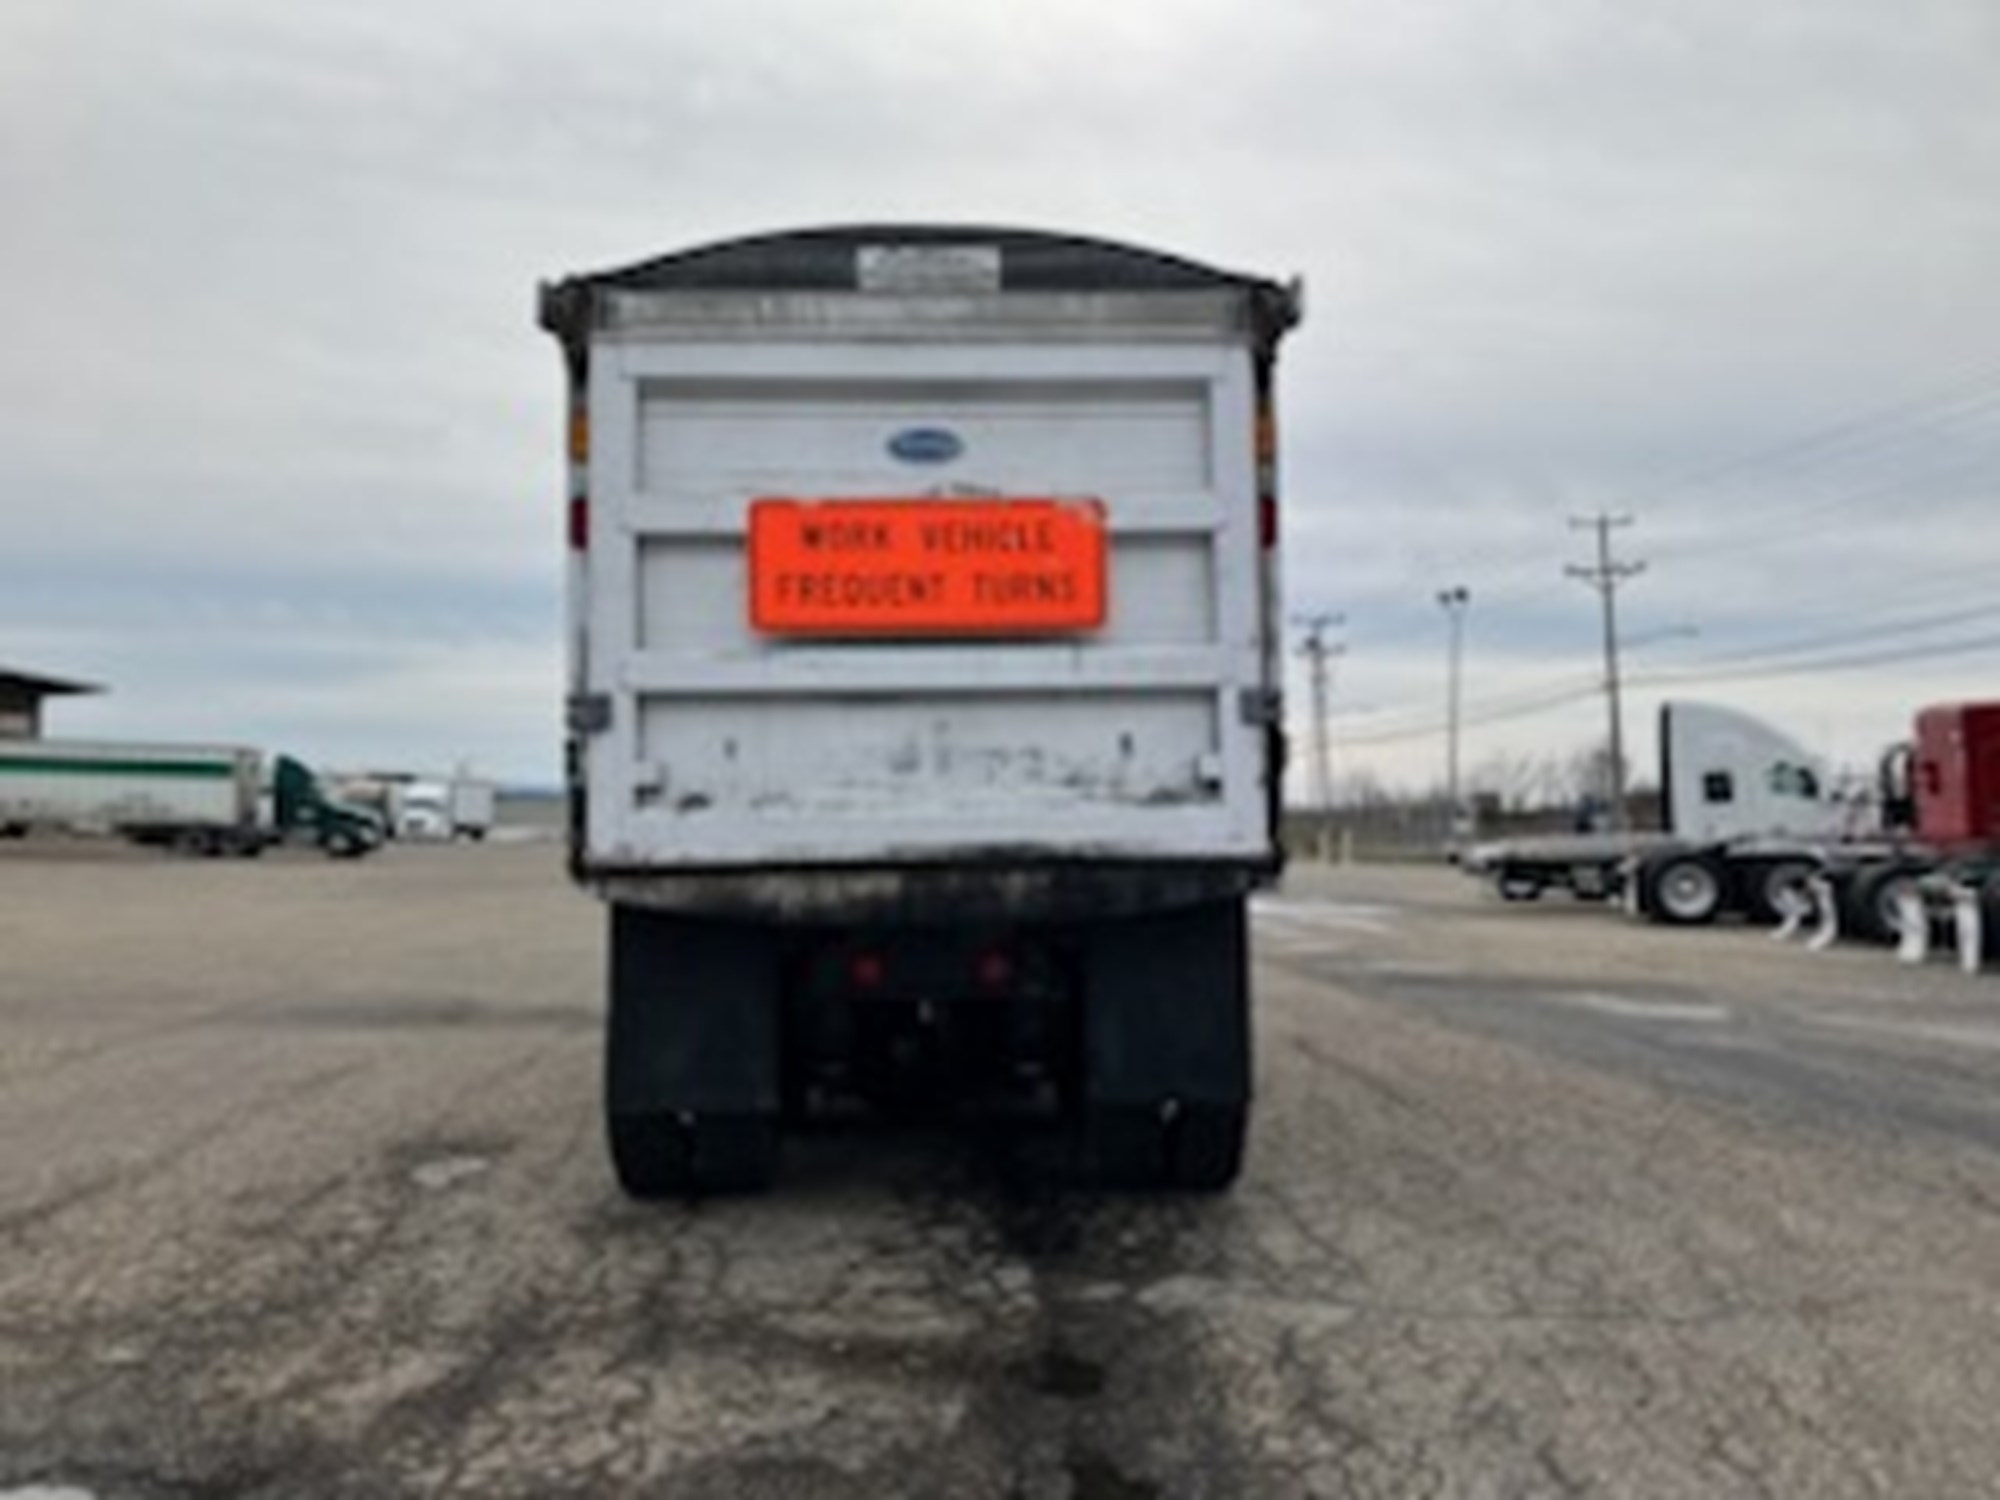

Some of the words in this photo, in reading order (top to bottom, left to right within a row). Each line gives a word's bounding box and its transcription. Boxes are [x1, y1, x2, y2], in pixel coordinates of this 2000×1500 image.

[800, 521, 890, 550] WORK
[920, 520, 1054, 553] VEHICLE
[775, 572, 945, 606] FREQUENT
[973, 572, 1076, 604] TURNS
